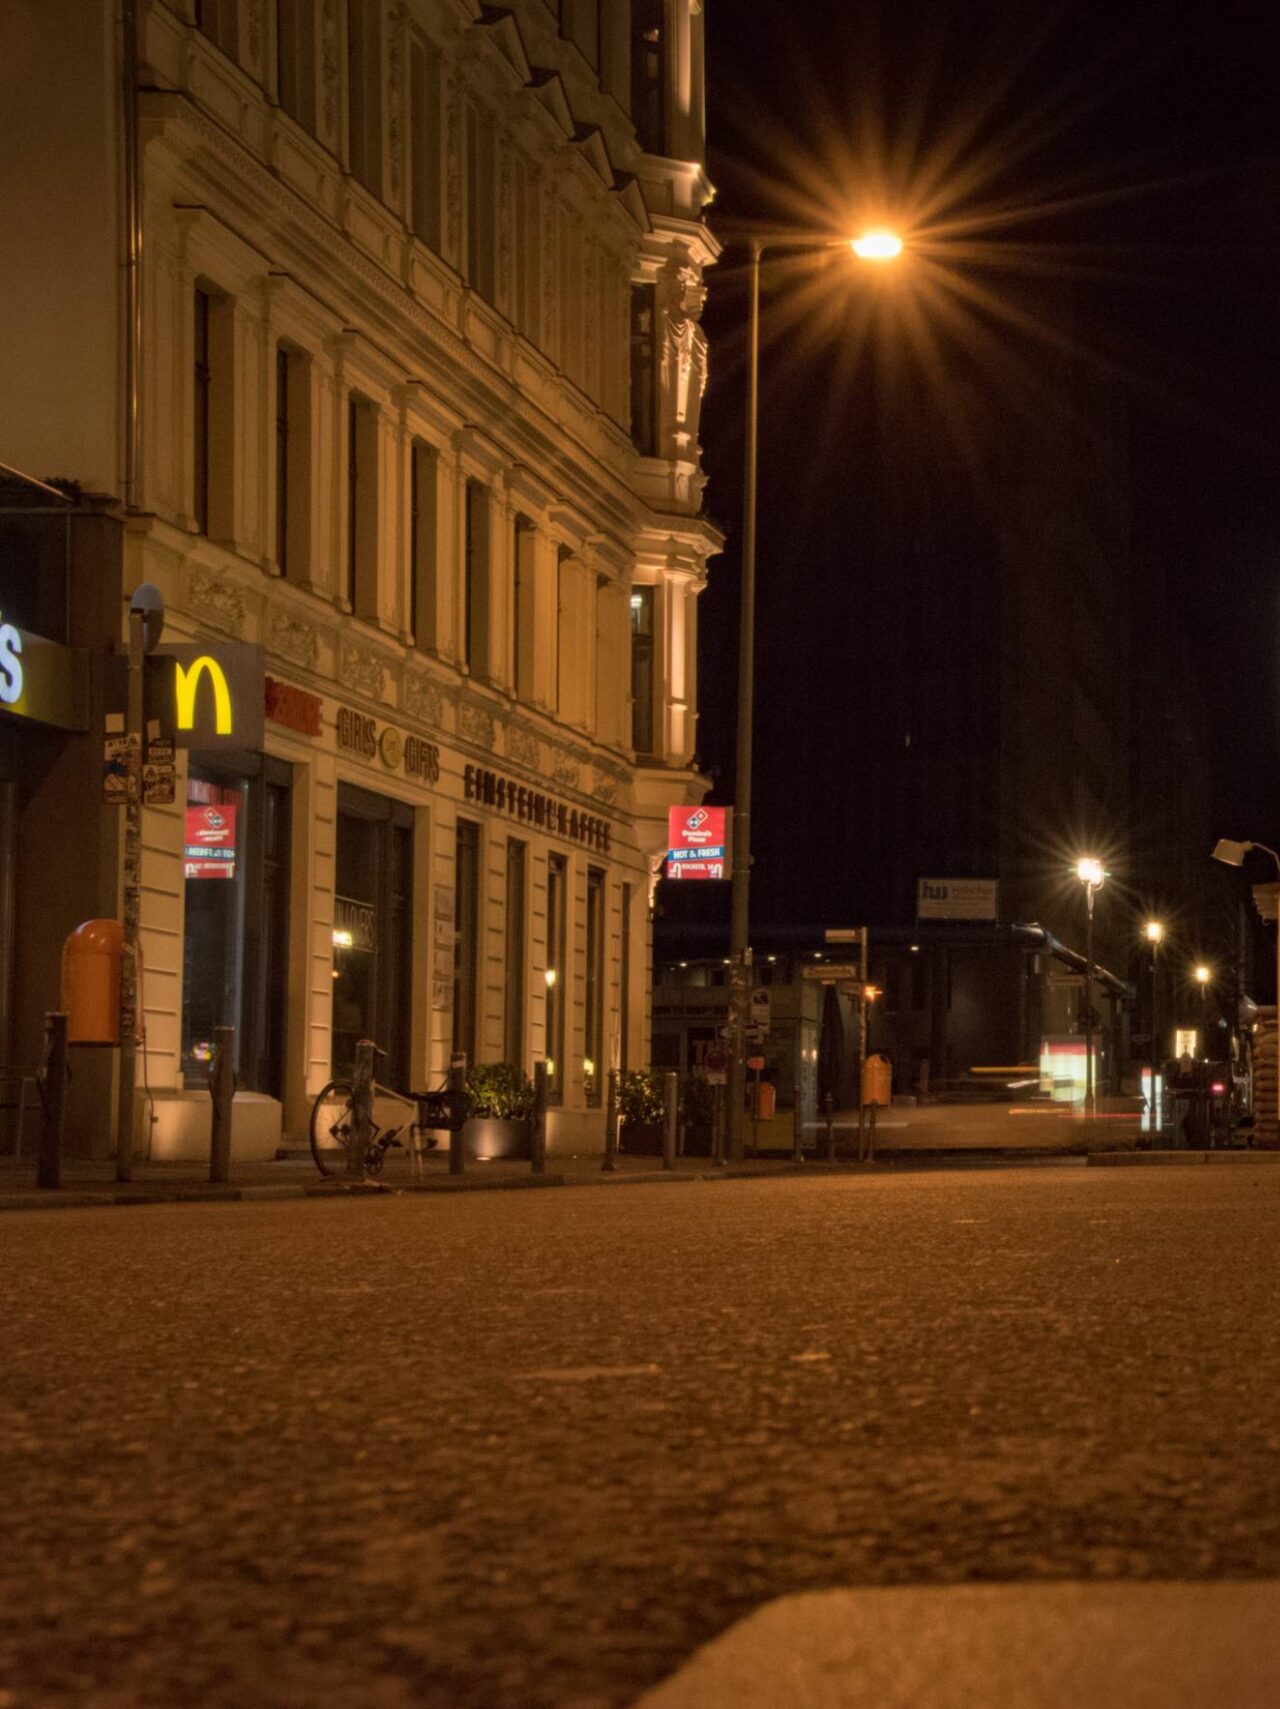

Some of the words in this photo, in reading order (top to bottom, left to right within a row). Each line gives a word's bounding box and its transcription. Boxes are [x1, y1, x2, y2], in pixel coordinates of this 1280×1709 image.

[464, 763, 546, 826] EINSTEIN
[558, 803, 611, 851] KAFFEE
[673, 850, 688, 860] HOT
[689, 849, 697, 858] &
[697, 847, 720, 858] FRESH
